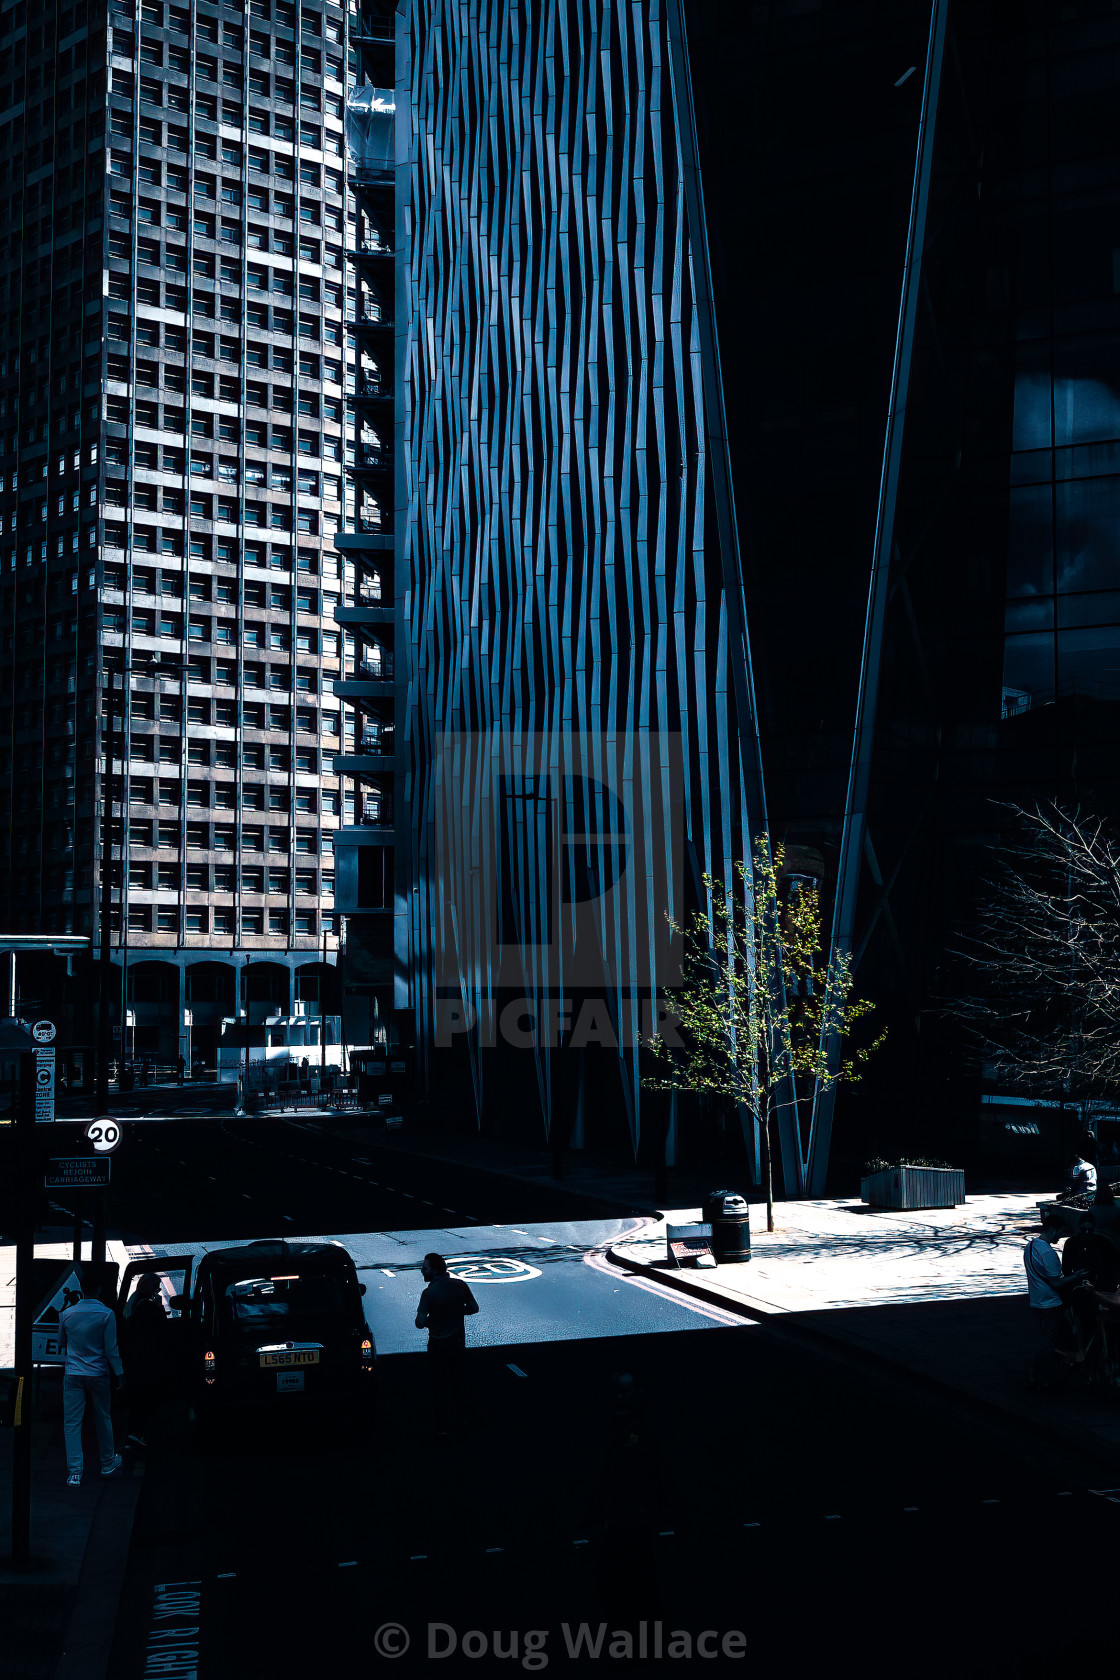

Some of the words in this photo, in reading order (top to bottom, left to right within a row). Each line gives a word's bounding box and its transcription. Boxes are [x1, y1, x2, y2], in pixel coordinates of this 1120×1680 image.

[90, 1127, 118, 1143] 20
[63, 1168, 93, 1176] REJOIN
[48, 1175, 107, 1184] CARRIAGEWAY
[152, 1581, 203, 1620] LOOK
